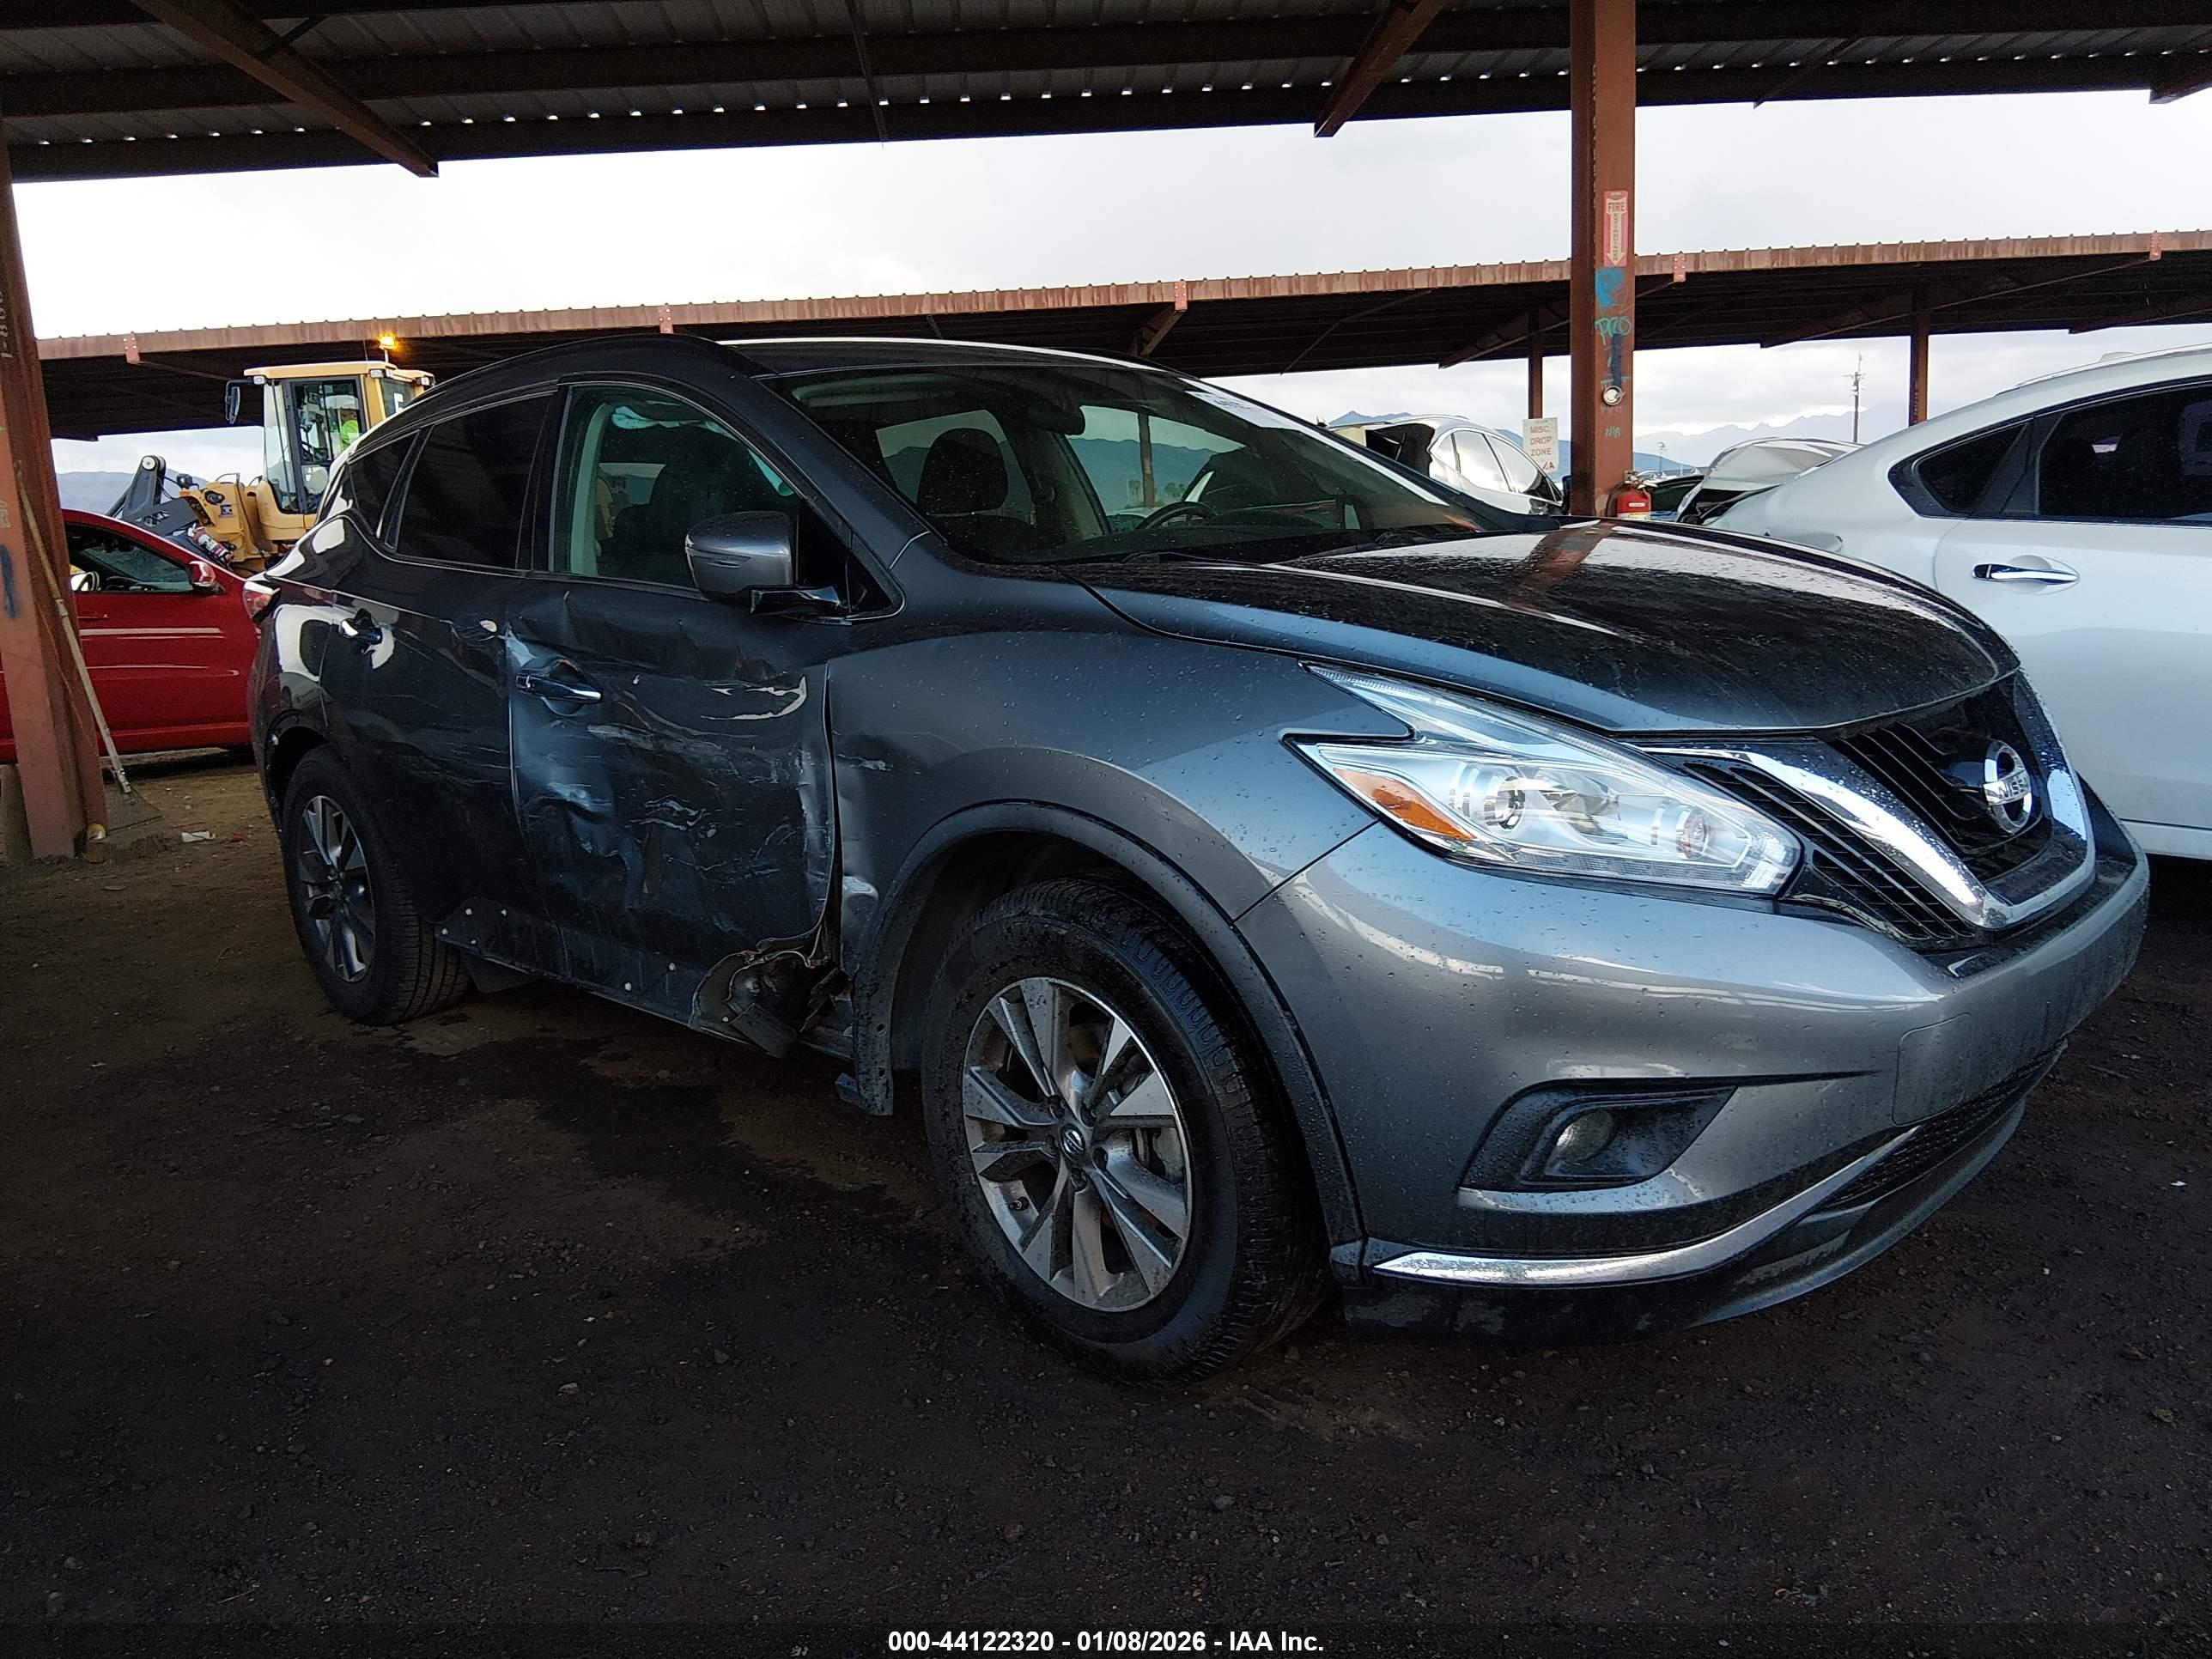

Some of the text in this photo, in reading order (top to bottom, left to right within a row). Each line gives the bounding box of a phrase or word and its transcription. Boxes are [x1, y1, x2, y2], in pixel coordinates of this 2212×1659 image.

[1607, 202, 1626, 212] FIRE
[1530, 435, 1552, 446] DROP
[1530, 447, 1552, 457] ZONE
